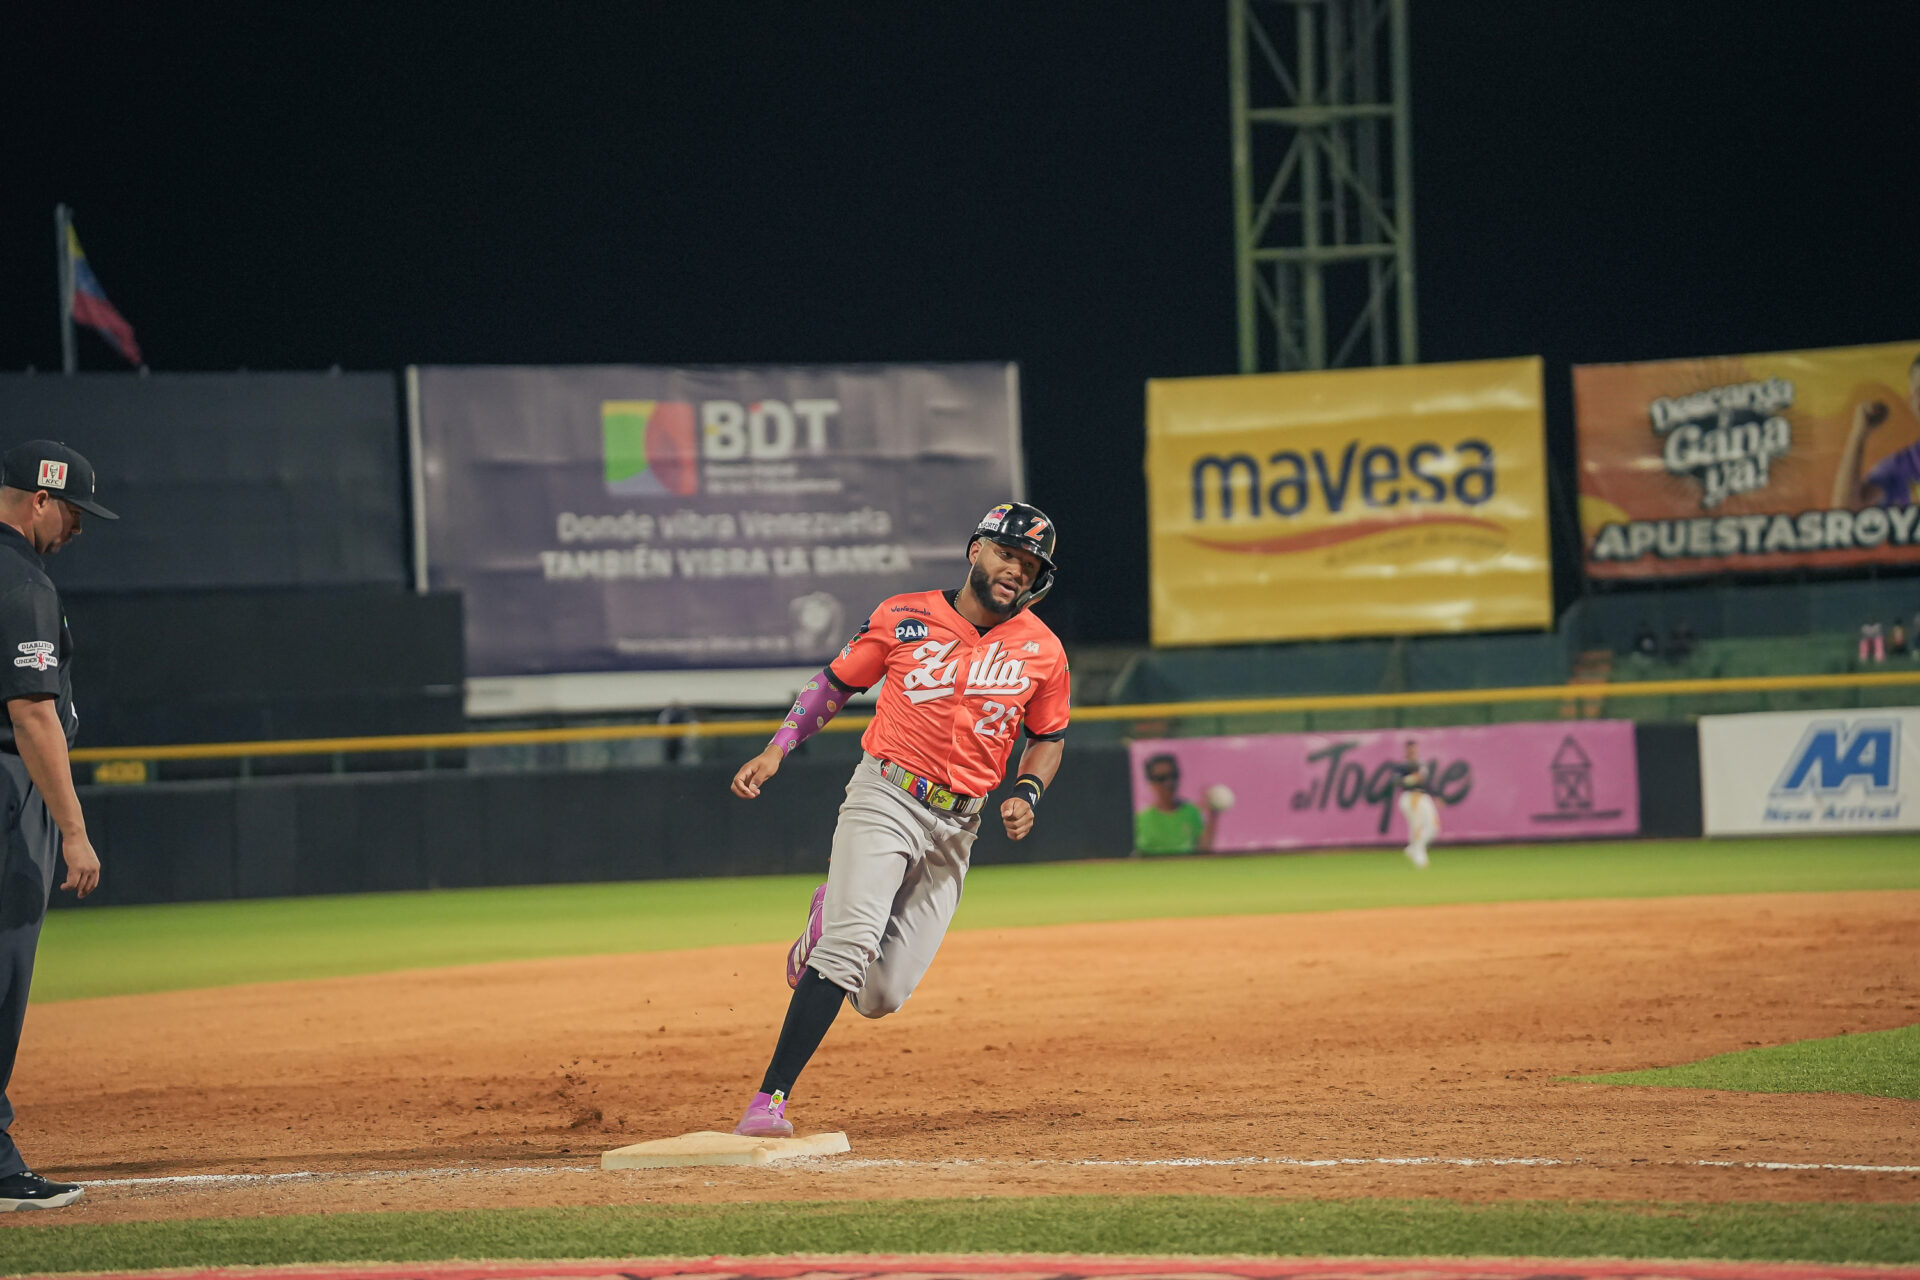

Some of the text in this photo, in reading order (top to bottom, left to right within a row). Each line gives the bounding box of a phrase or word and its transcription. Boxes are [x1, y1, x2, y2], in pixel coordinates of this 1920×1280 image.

[703, 399, 839, 460] BDT
[1665, 416, 1791, 470] Gana
[1191, 437, 1495, 520] mavesa
[1024, 517, 1048, 541] Z
[1595, 506, 1920, 558] APUESTASROY
[903, 640, 1030, 705] Zulia
[1764, 802, 1900, 821] New Arrival
